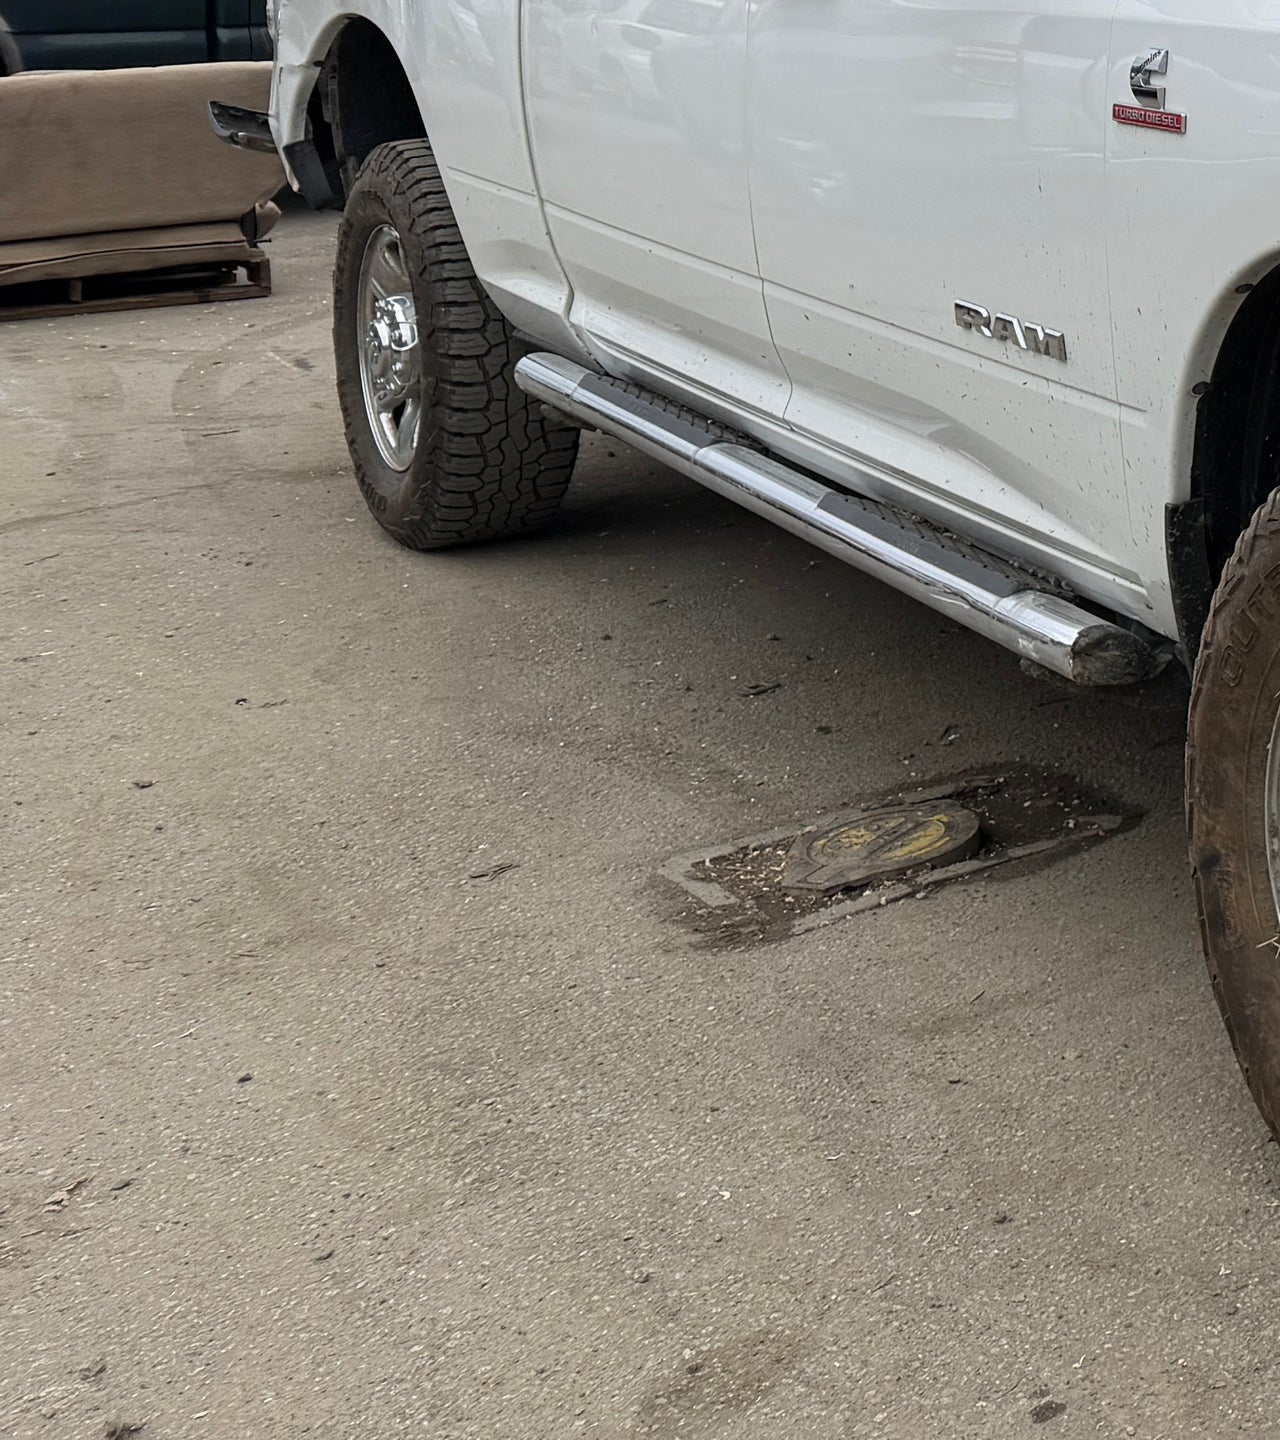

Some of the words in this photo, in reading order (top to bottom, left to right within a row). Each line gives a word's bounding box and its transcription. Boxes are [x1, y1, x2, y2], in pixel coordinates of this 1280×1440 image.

[1114, 106, 1145, 120] TURBO
[1145, 110, 1182, 127] DIESEL
[954, 298, 1068, 362] RAM
